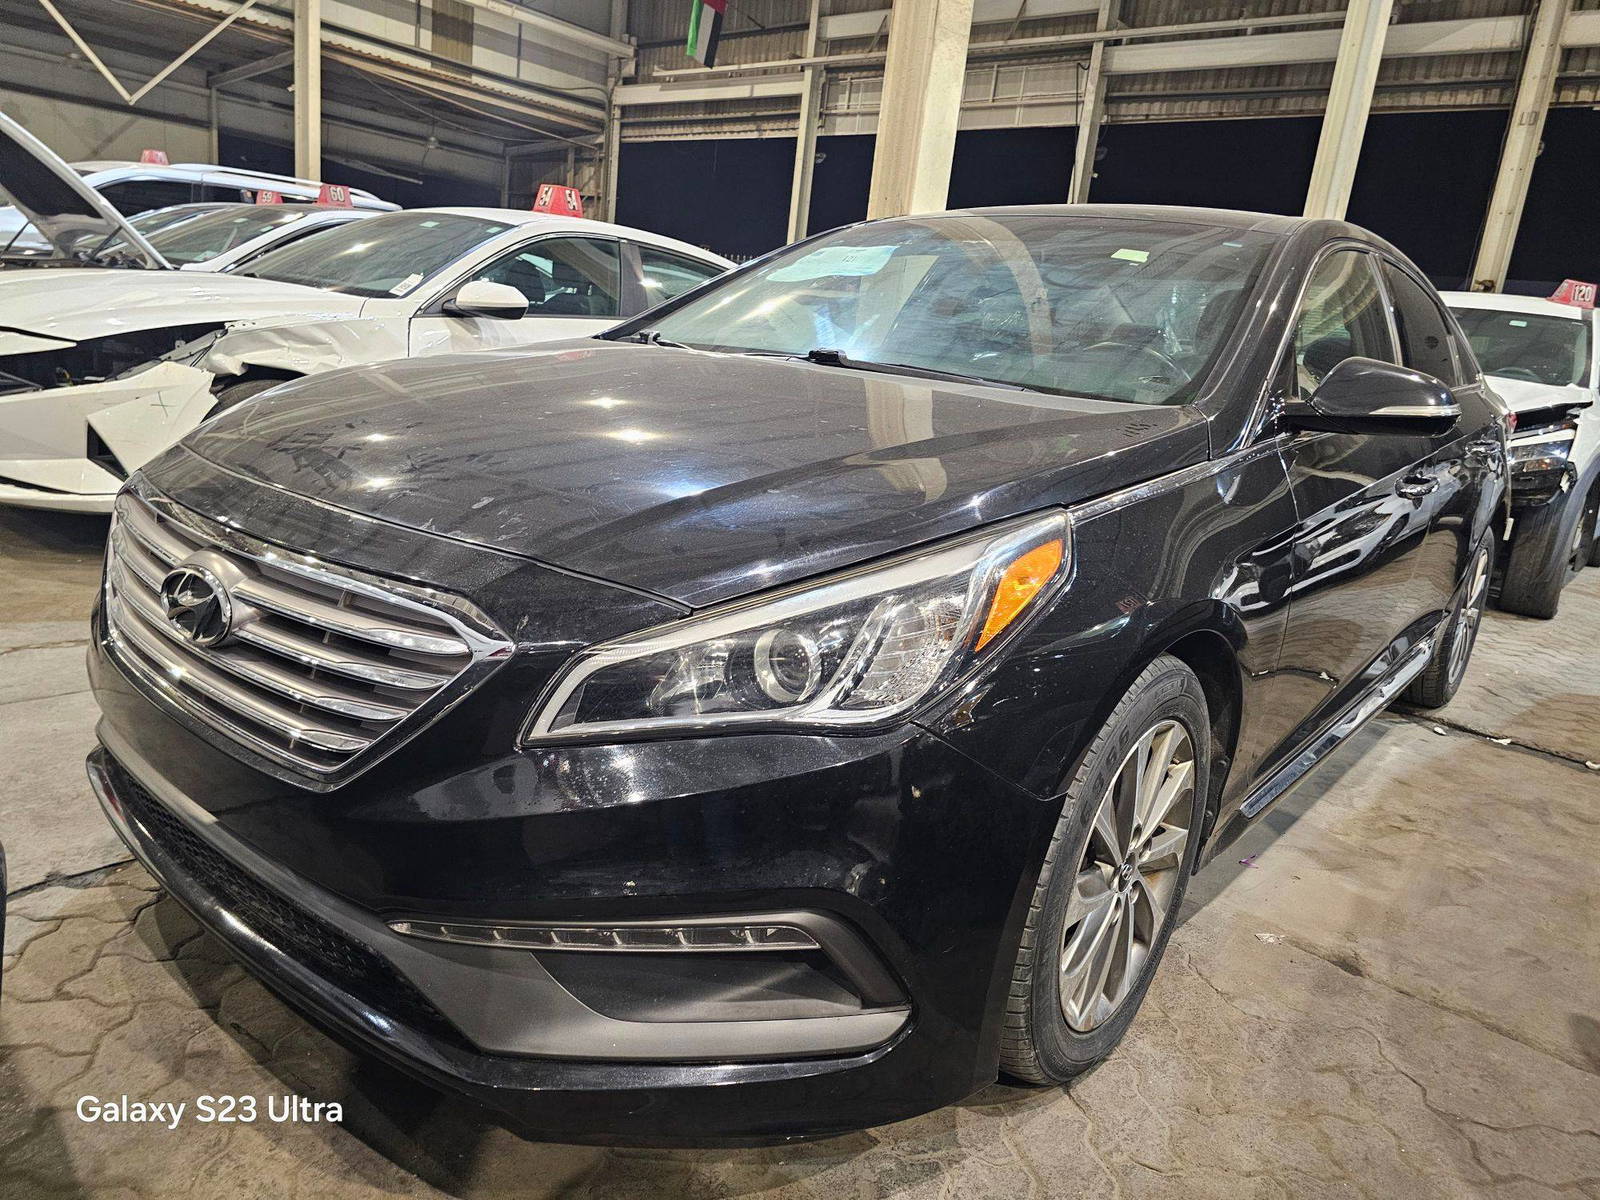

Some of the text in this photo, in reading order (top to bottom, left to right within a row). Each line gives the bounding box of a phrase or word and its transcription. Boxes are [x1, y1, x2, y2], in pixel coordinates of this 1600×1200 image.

[329, 187, 345, 202] 60
[539, 186, 553, 206] 54
[565, 189, 578, 210] 54
[1574, 285, 1593, 302] 120
